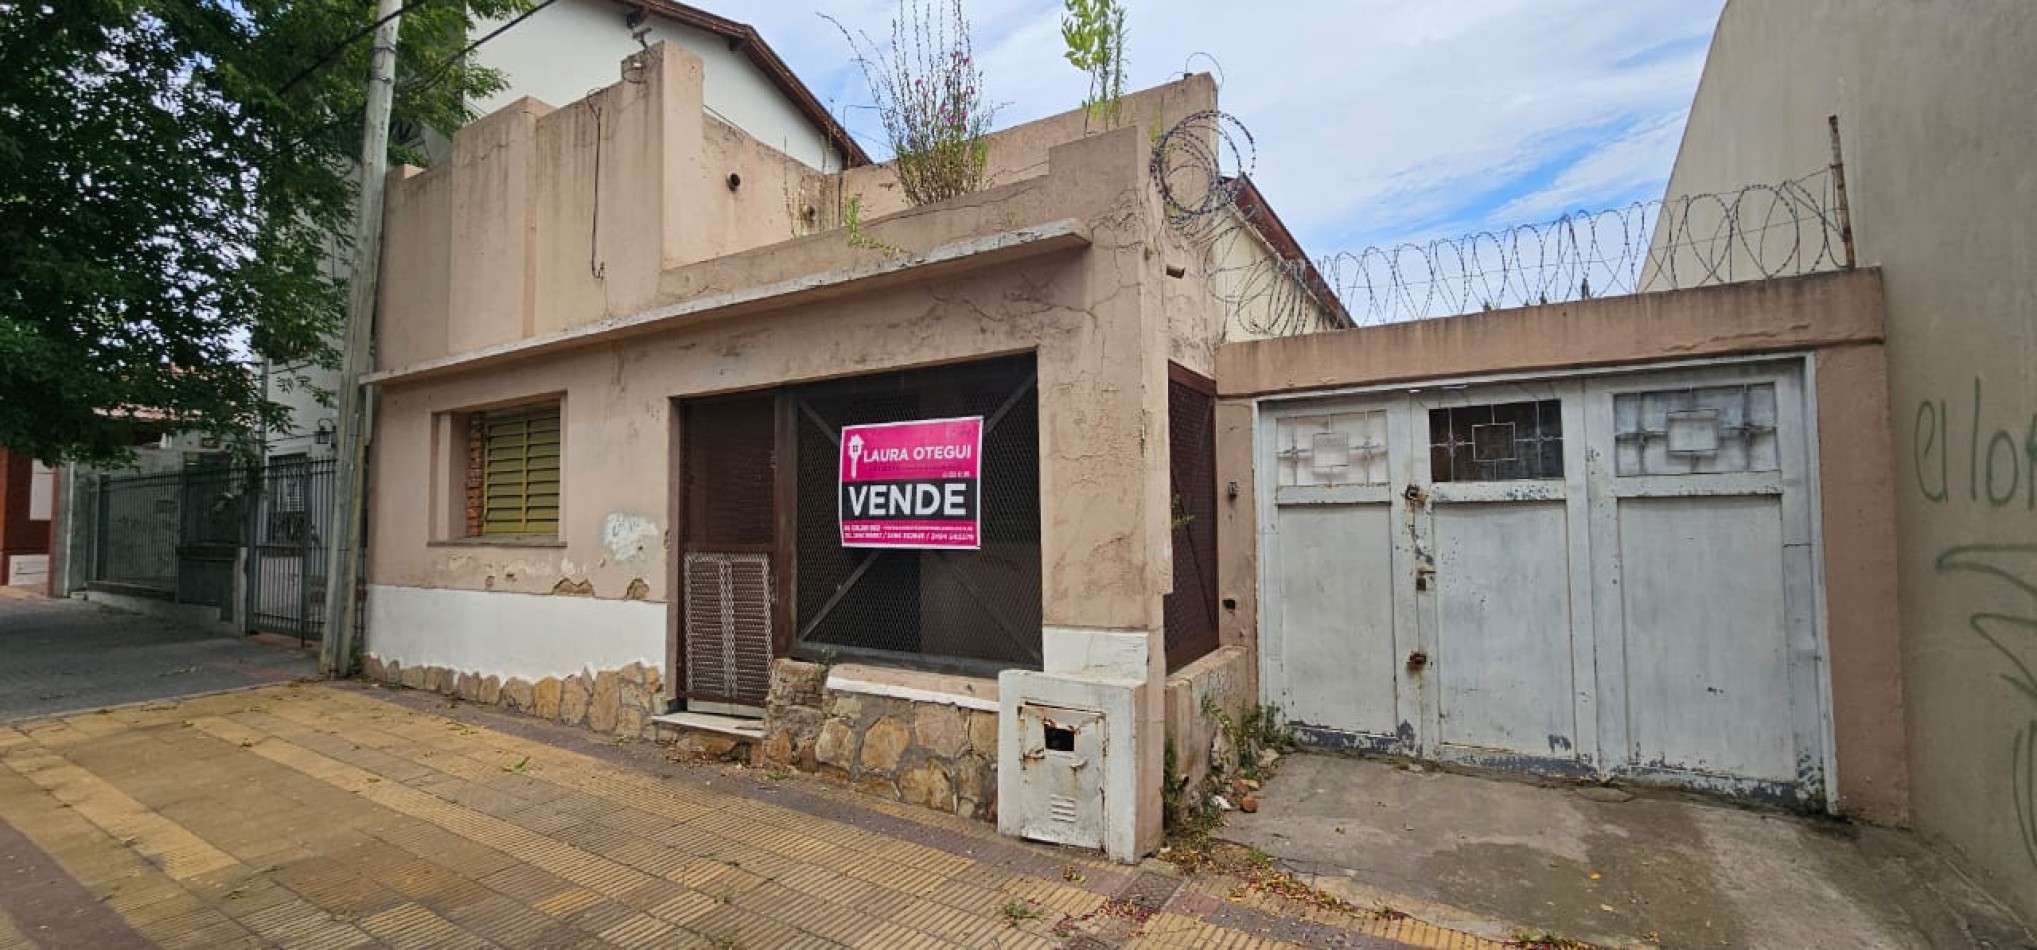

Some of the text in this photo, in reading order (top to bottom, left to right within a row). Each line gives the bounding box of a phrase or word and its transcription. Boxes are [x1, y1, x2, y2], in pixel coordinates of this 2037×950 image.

[863, 444, 972, 463] LAURA OTEGUI
[847, 483, 967, 516] VENDE
